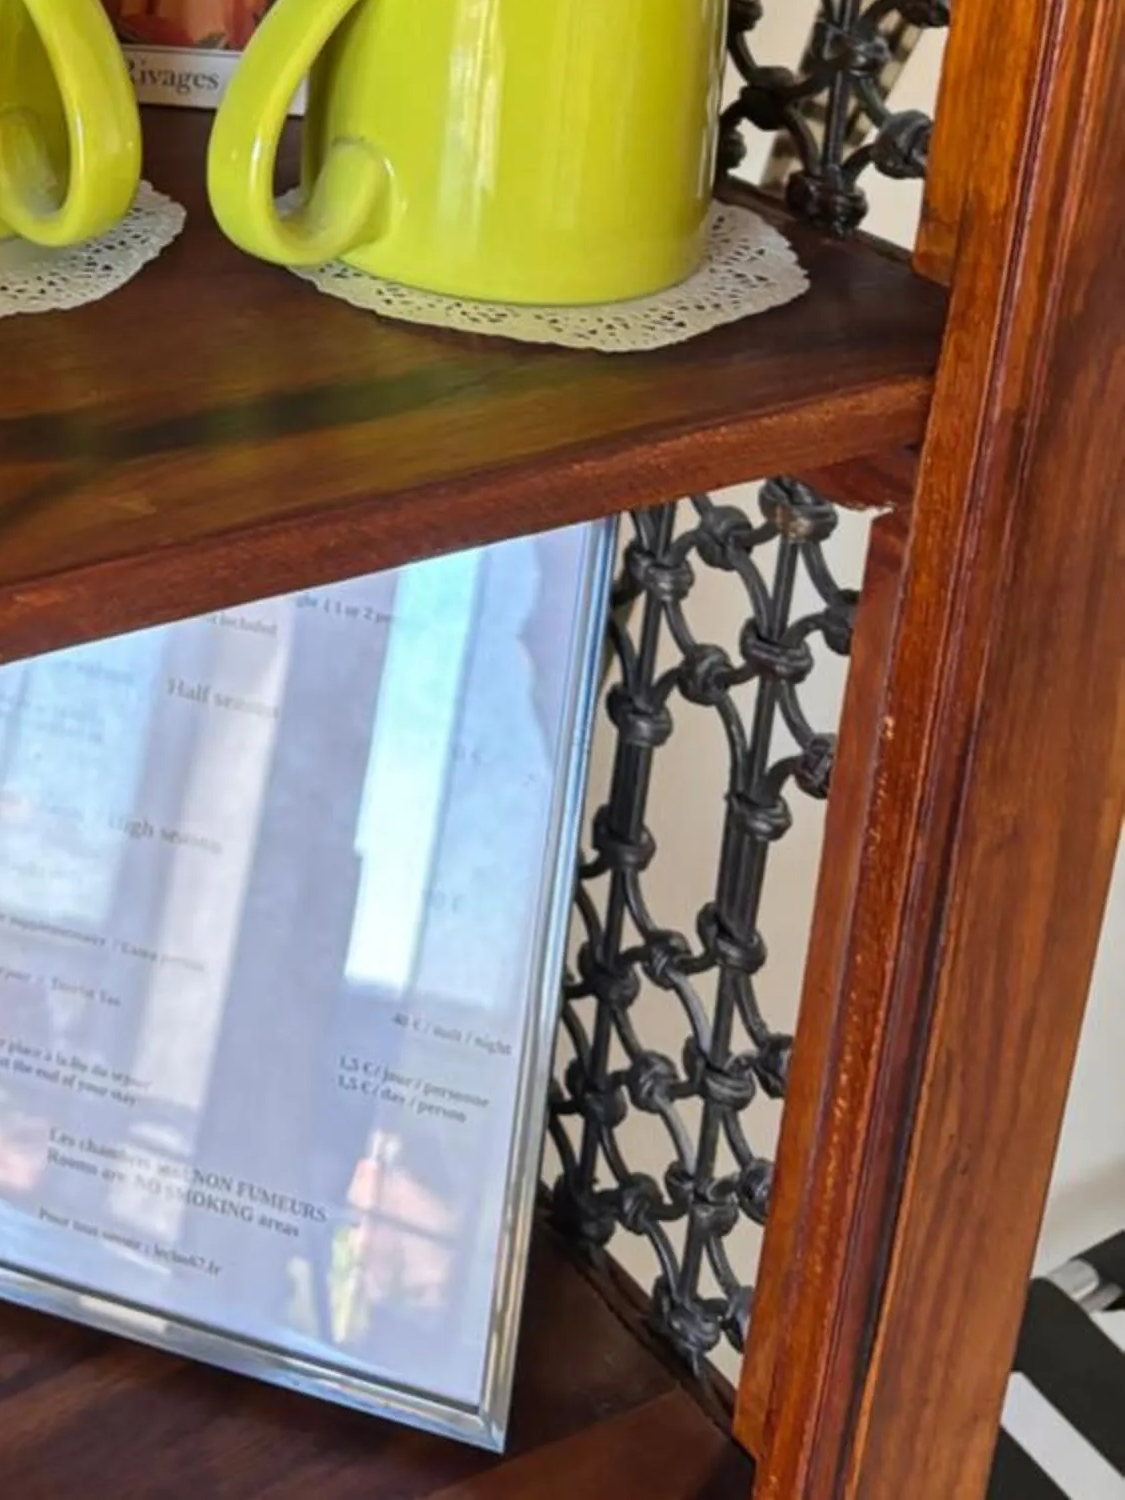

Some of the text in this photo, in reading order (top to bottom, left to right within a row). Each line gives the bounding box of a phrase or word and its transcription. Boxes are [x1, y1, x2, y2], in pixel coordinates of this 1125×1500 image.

[133, 1173, 162, 1196] NO
[257, 1213, 300, 1238] areas
[191, 1166, 233, 1193] NON
[235, 1180, 328, 1223] FUMEURS
